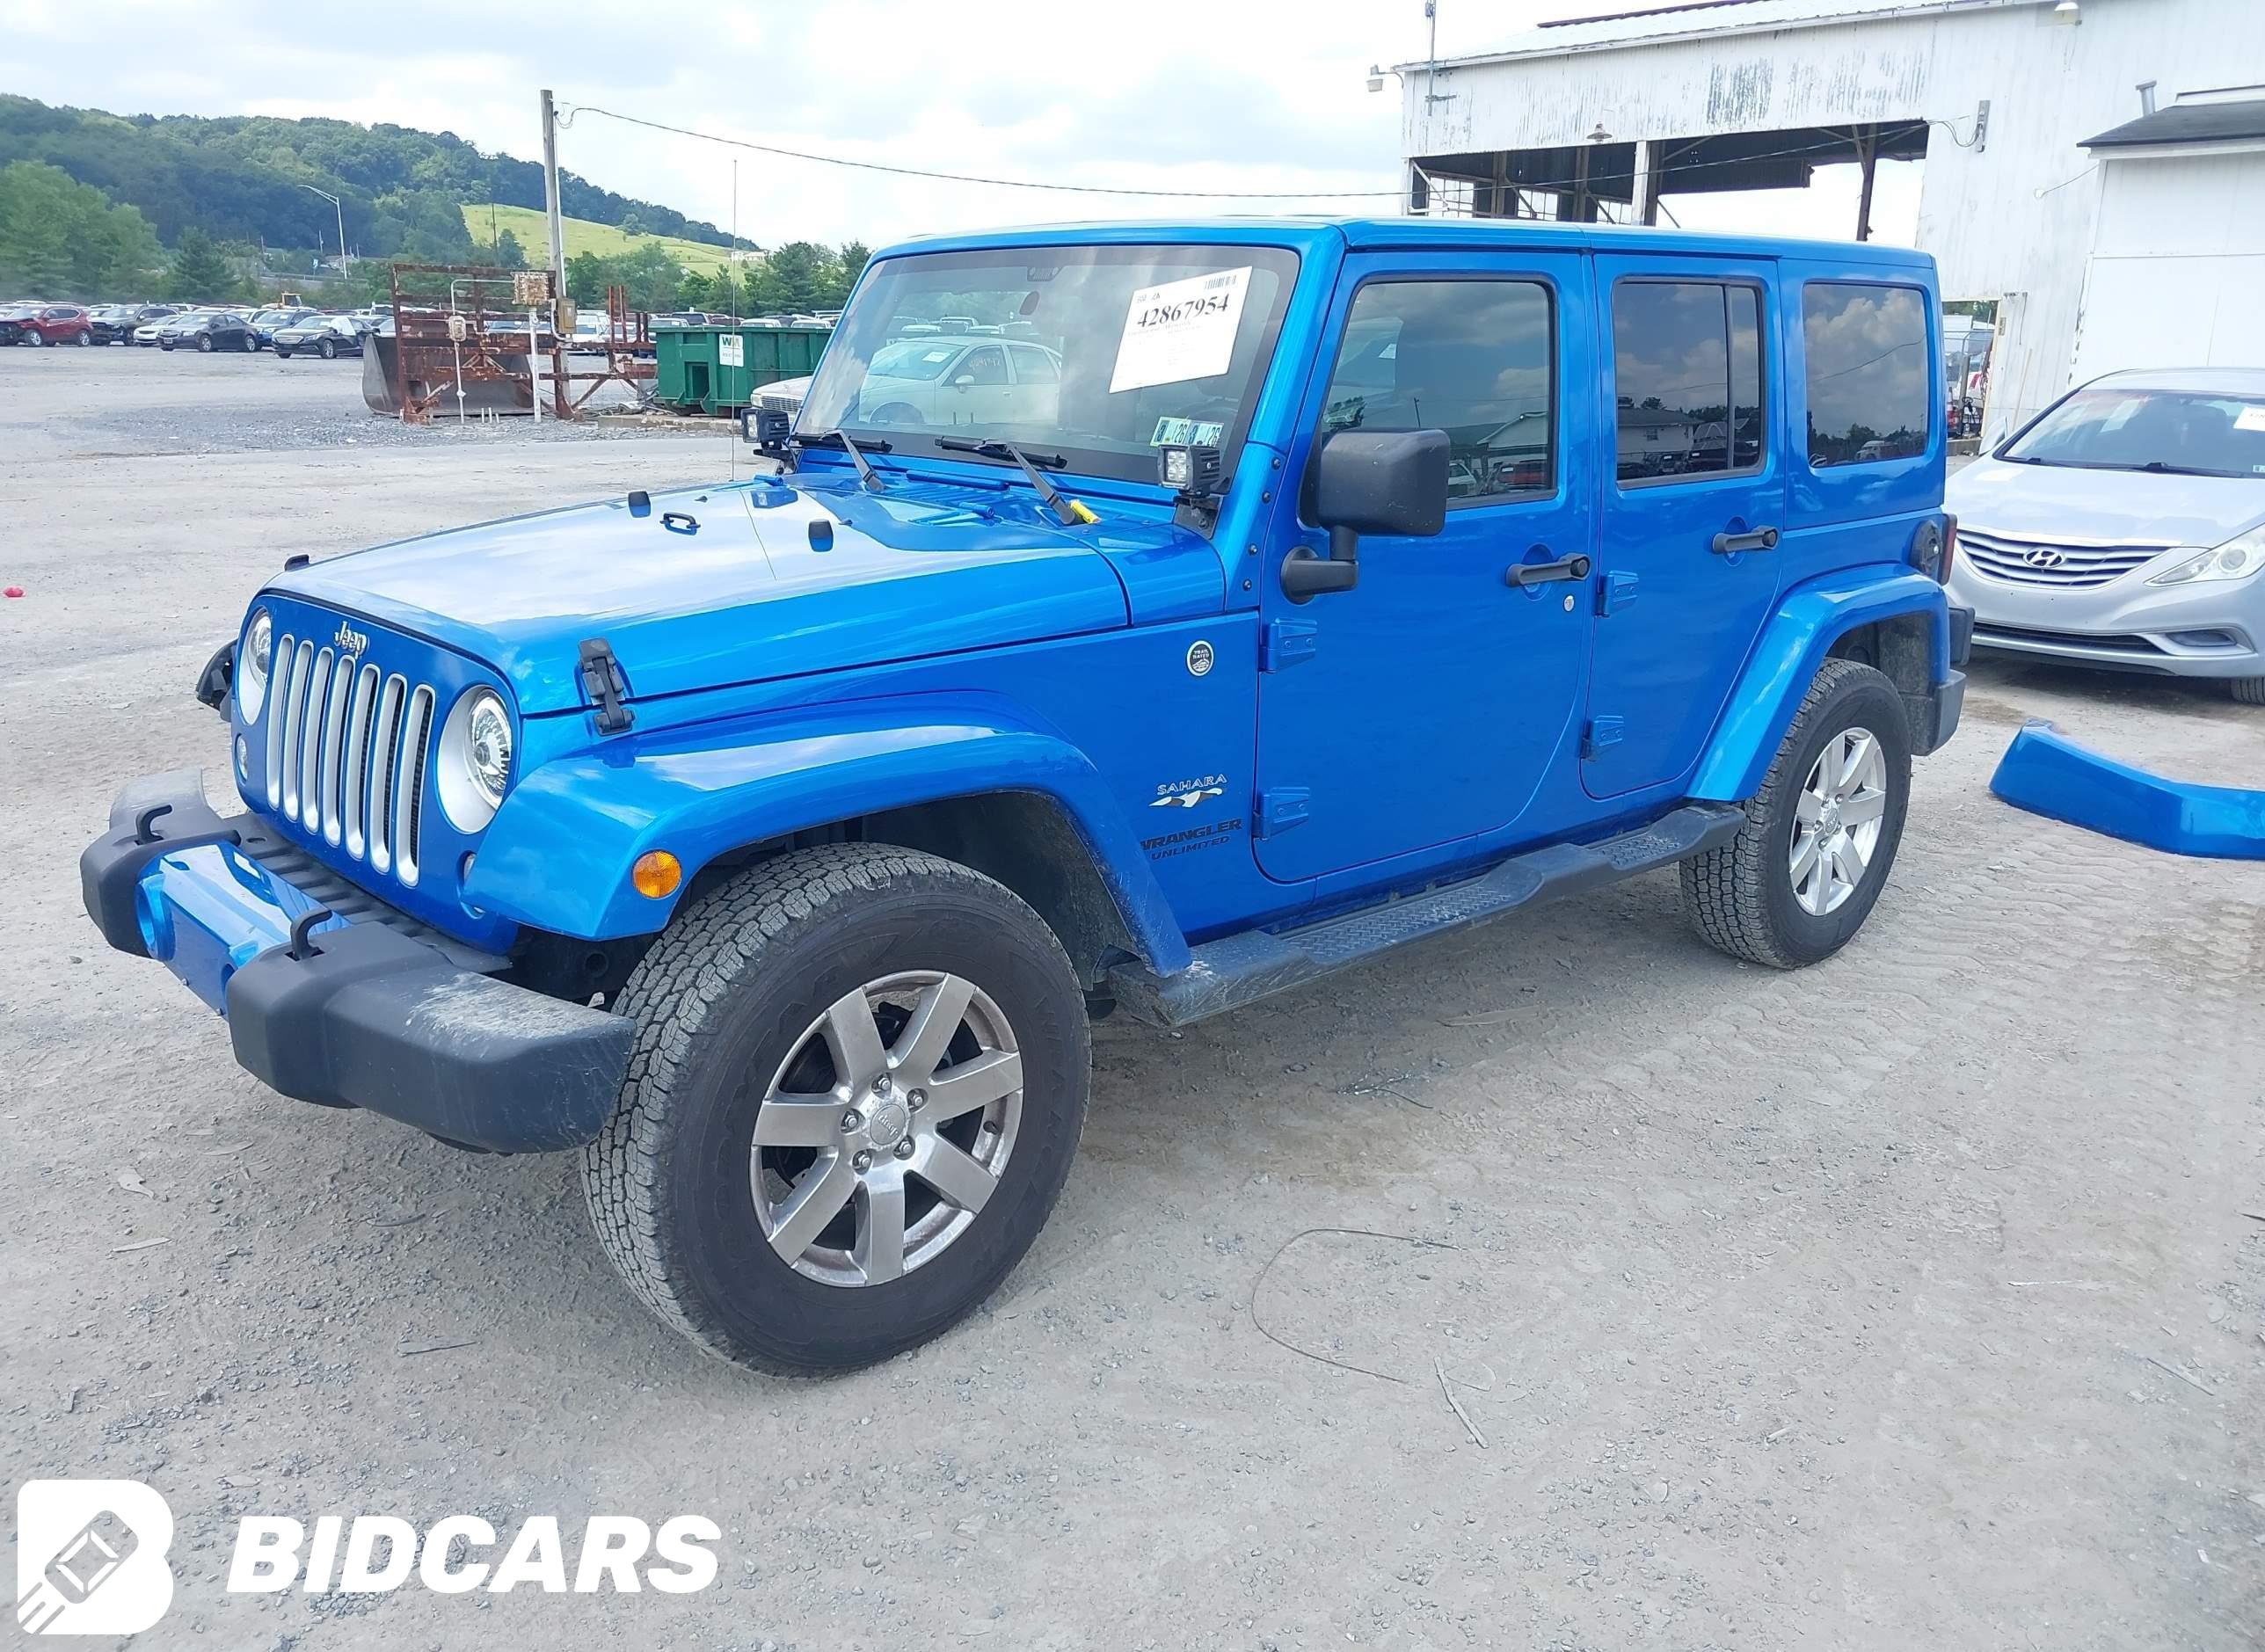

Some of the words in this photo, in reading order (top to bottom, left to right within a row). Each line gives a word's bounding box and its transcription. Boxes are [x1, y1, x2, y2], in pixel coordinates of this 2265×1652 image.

[1137, 293, 1229, 328] 42867954
[334, 621, 369, 660] Jeep
[1156, 773, 1227, 795] SAHARA
[1140, 818, 1243, 851] WRANGLER
[1151, 835, 1230, 861] UNLIMITED
